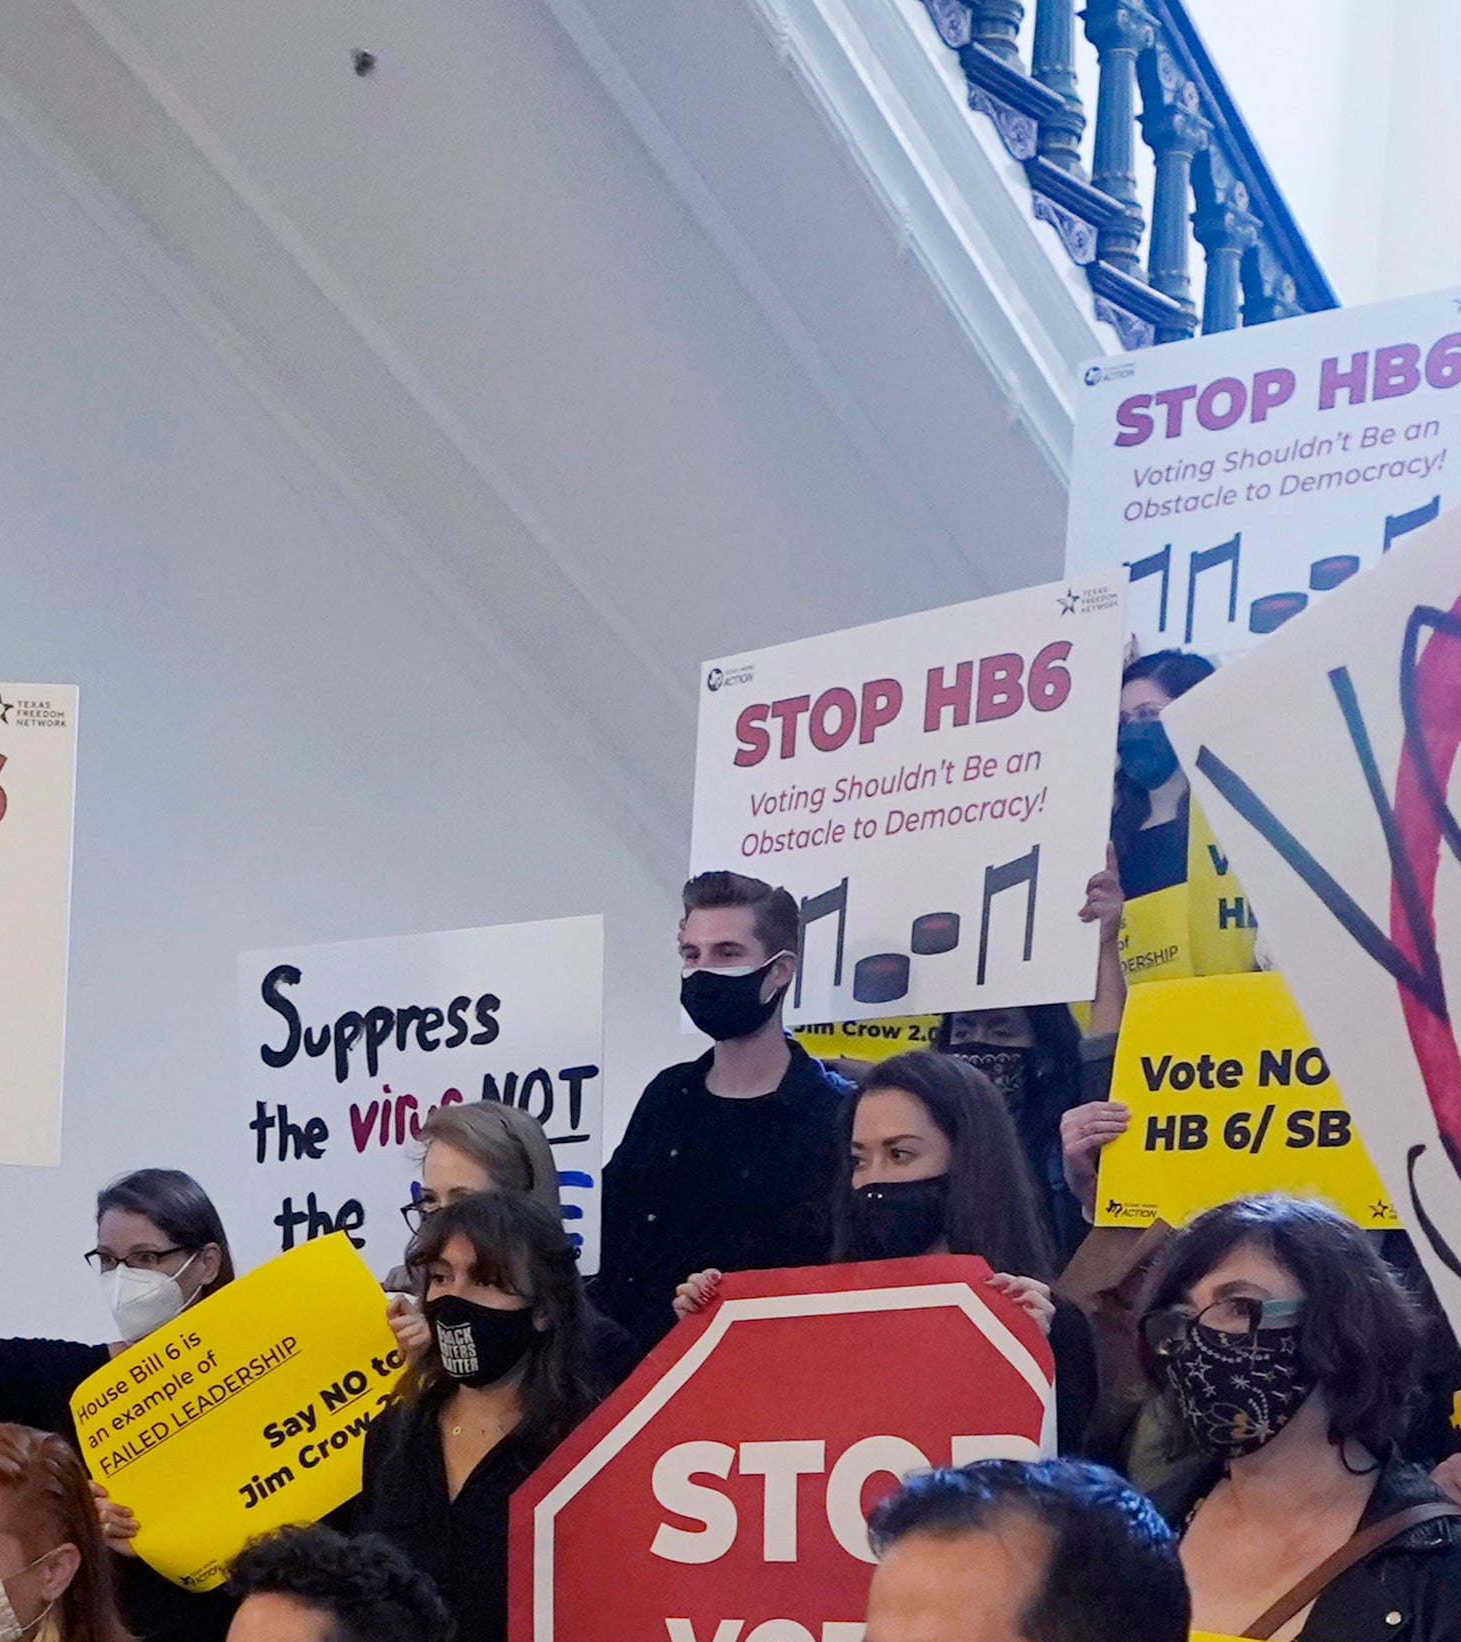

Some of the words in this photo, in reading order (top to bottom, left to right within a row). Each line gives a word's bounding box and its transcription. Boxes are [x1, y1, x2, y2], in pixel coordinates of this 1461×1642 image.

[1113, 368, 1295, 448] STOP
[1124, 486, 1237, 522] Obstacle
[1246, 481, 1271, 502] to
[1279, 448, 1447, 497] Democracy!
[1132, 458, 1215, 489] Voting
[1222, 430, 1351, 474] Shouldn't
[1359, 425, 1395, 449] Be
[1404, 418, 1440, 441] an
[16, 718, 67, 728] NETWORK
[17, 701, 51, 709] TEXAS
[17, 709, 66, 718] FREEDOM
[734, 678, 903, 768] STOP
[924, 640, 1073, 732] HB6
[749, 783, 825, 818] Voting
[833, 758, 955, 804] Shouldn't
[963, 753, 997, 780] Be
[1006, 749, 1042, 773] an
[741, 820, 846, 858] Obstacle
[854, 815, 877, 840] to
[885, 787, 1047, 836] Democracy!
[260, 964, 501, 1083] Suppress
[842, 1023, 902, 1040] Crow
[1140, 1055, 1243, 1092] Vote
[1258, 1047, 1331, 1087] NO
[249, 1100, 329, 1164] the
[1145, 1113, 1209, 1151] HB
[1223, 1104, 1276, 1154] 6/
[1285, 1110, 1352, 1148] SB
[77, 1380, 129, 1425] House
[130, 1359, 165, 1384] Bill
[165, 1343, 181, 1361] 6
[179, 1331, 202, 1350] is
[88, 1427, 109, 1449] an
[112, 1371, 194, 1430] example
[197, 1351, 217, 1374] of
[99, 1421, 170, 1476] FAILED
[175, 1336, 298, 1428] LEADERSHIP
[263, 1404, 317, 1448] Say
[319, 1370, 368, 1412] NO
[372, 1350, 406, 1378] to
[239, 1465, 295, 1509] Jim
[298, 1411, 374, 1469] Crow
